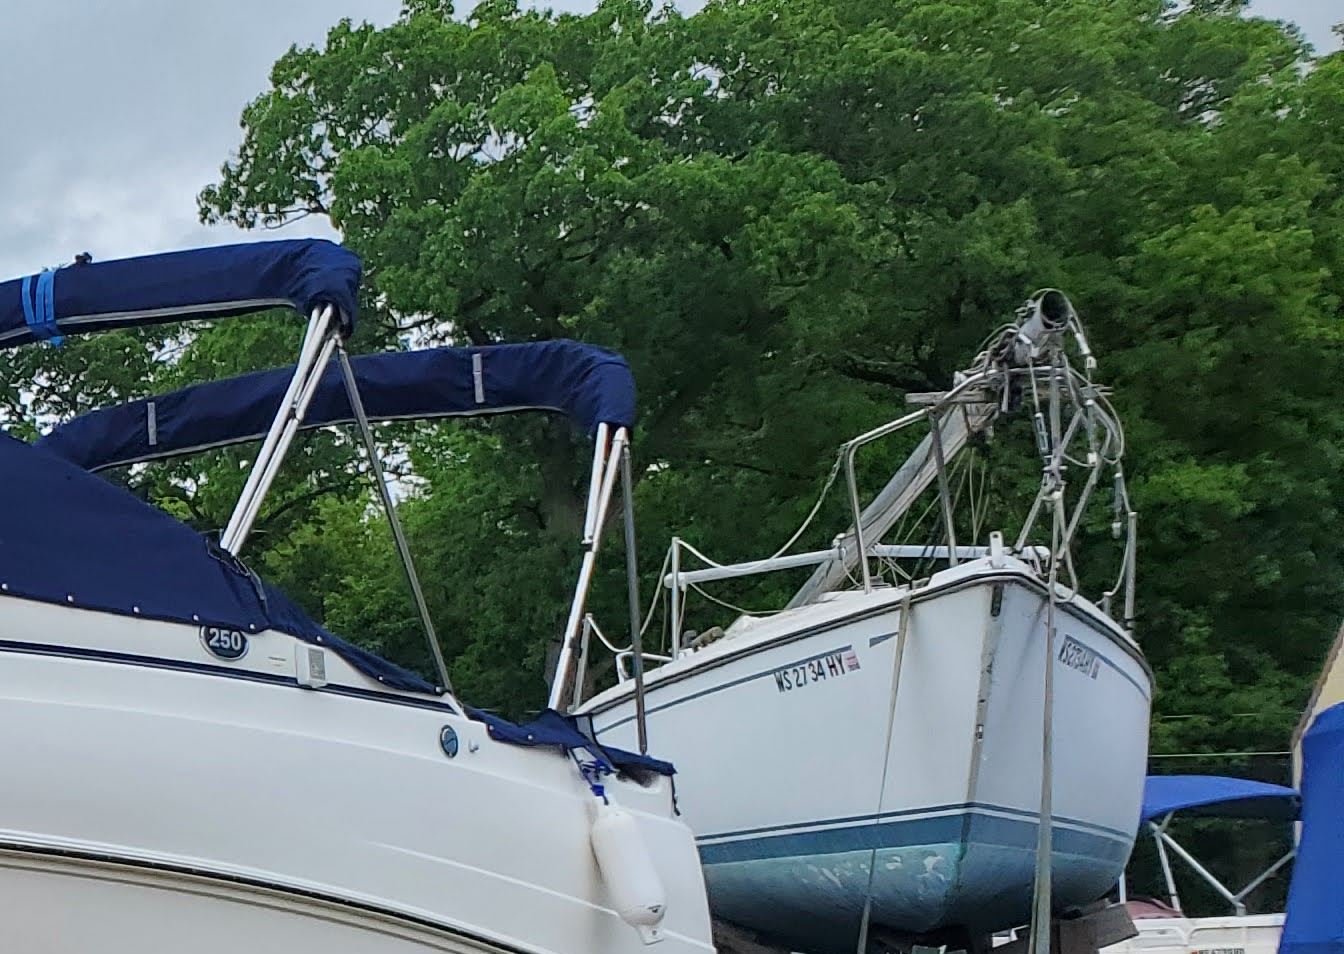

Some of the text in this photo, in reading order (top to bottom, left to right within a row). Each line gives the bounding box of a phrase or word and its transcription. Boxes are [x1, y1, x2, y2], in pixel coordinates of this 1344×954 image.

[209, 627, 242, 651] 250
[774, 670, 793, 693] WS
[826, 653, 845, 678] HY
